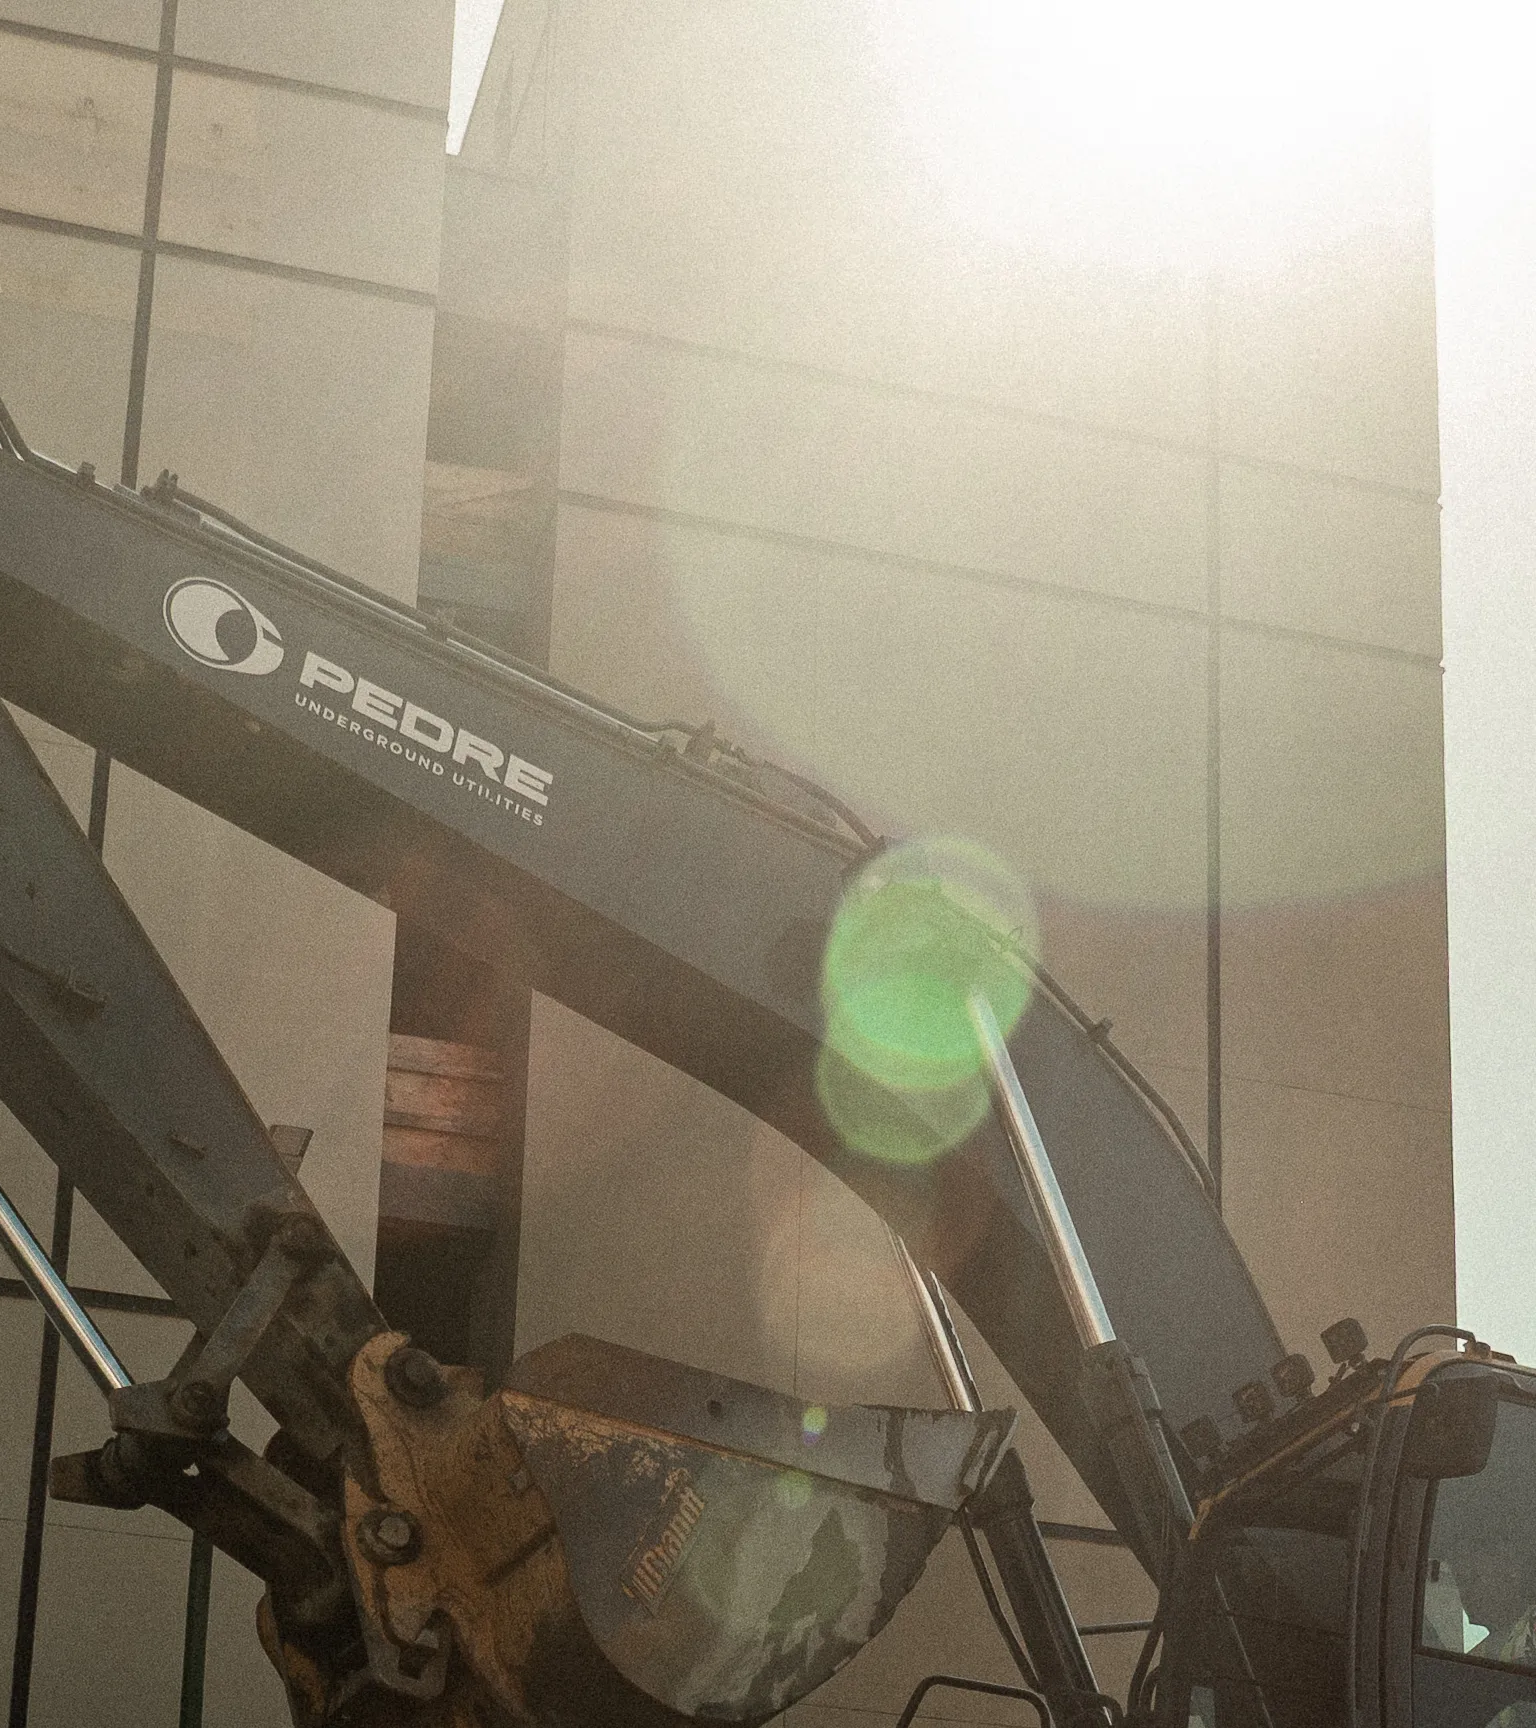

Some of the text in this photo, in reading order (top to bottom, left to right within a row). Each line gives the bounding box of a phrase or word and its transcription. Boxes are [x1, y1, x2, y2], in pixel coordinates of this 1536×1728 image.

[294, 692, 545, 827] UNDERGROUND UTILITIES
[299, 650, 554, 806] PEDRE
